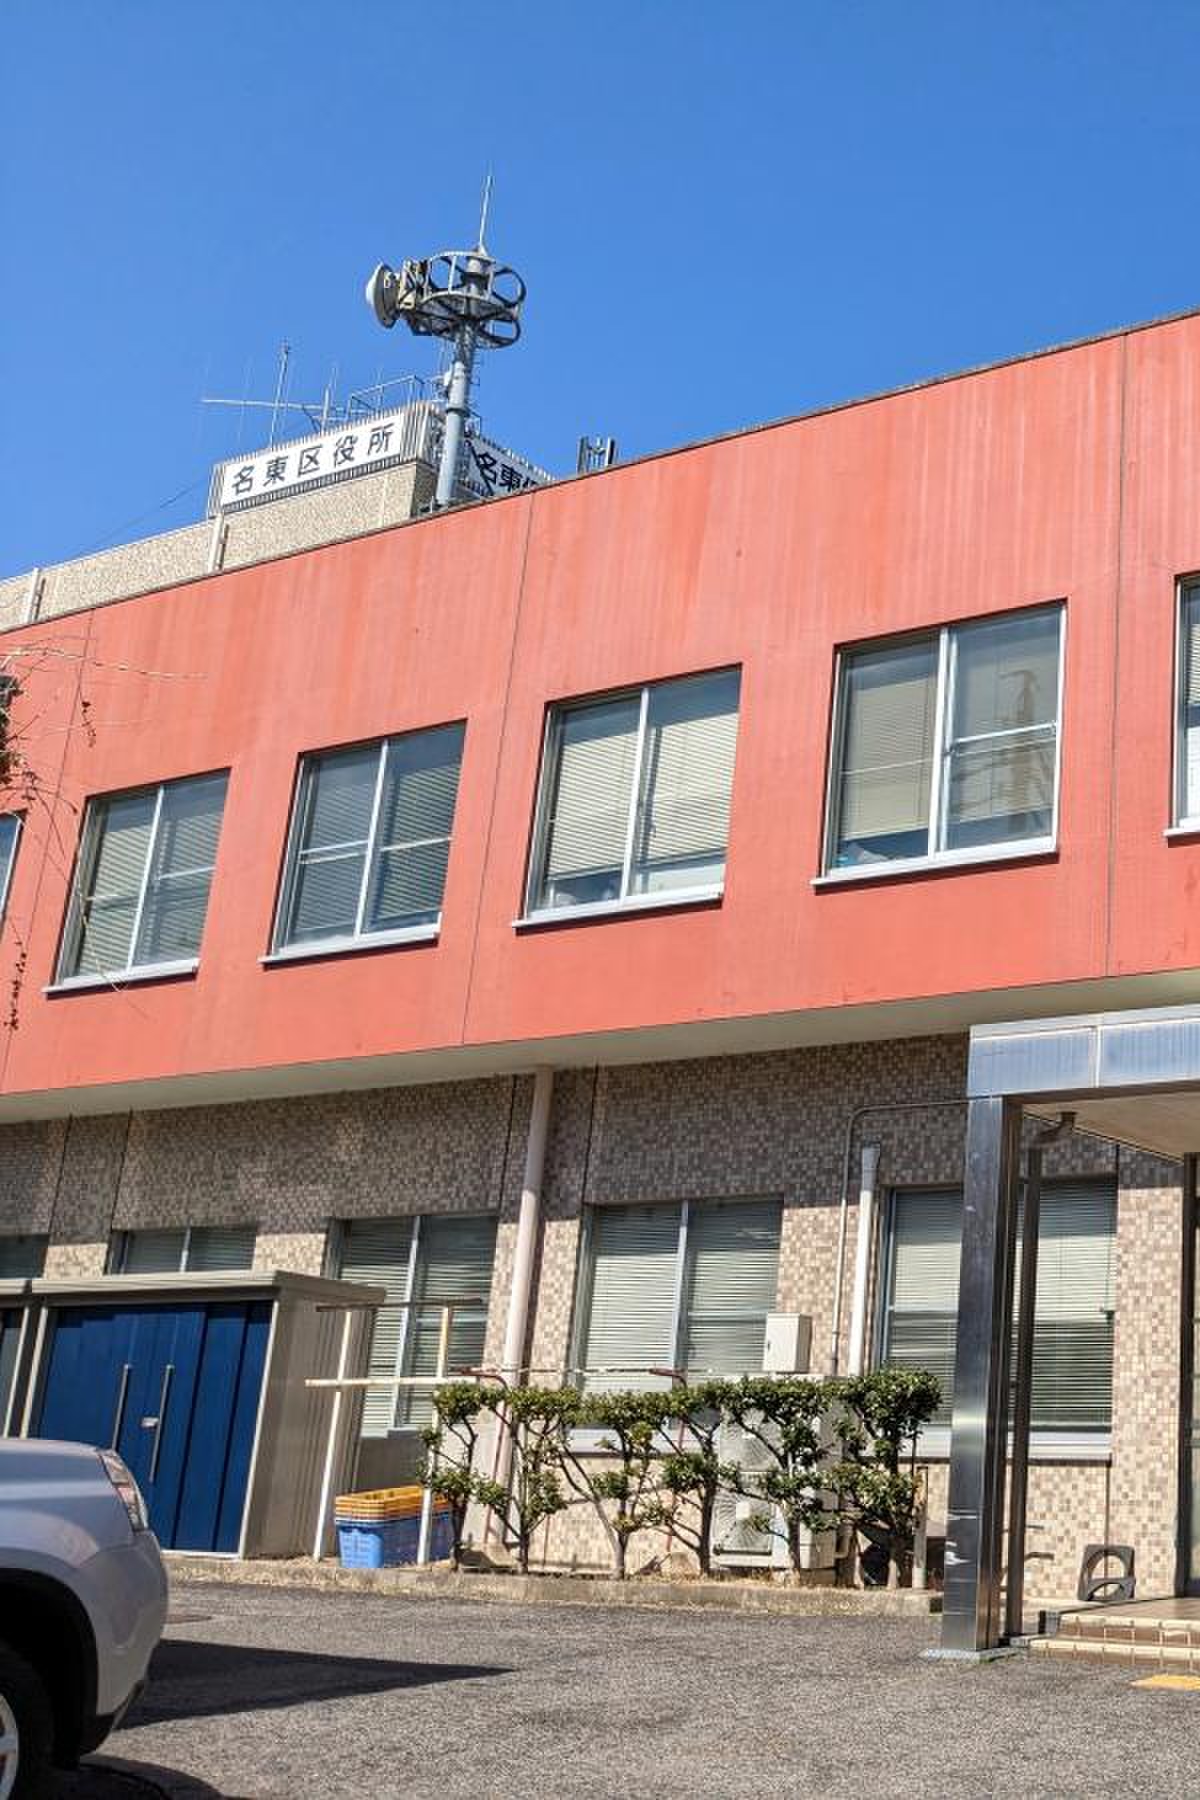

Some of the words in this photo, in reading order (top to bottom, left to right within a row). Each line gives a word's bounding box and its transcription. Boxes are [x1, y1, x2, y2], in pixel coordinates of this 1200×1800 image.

[231, 422, 395, 495] 名東区役所
